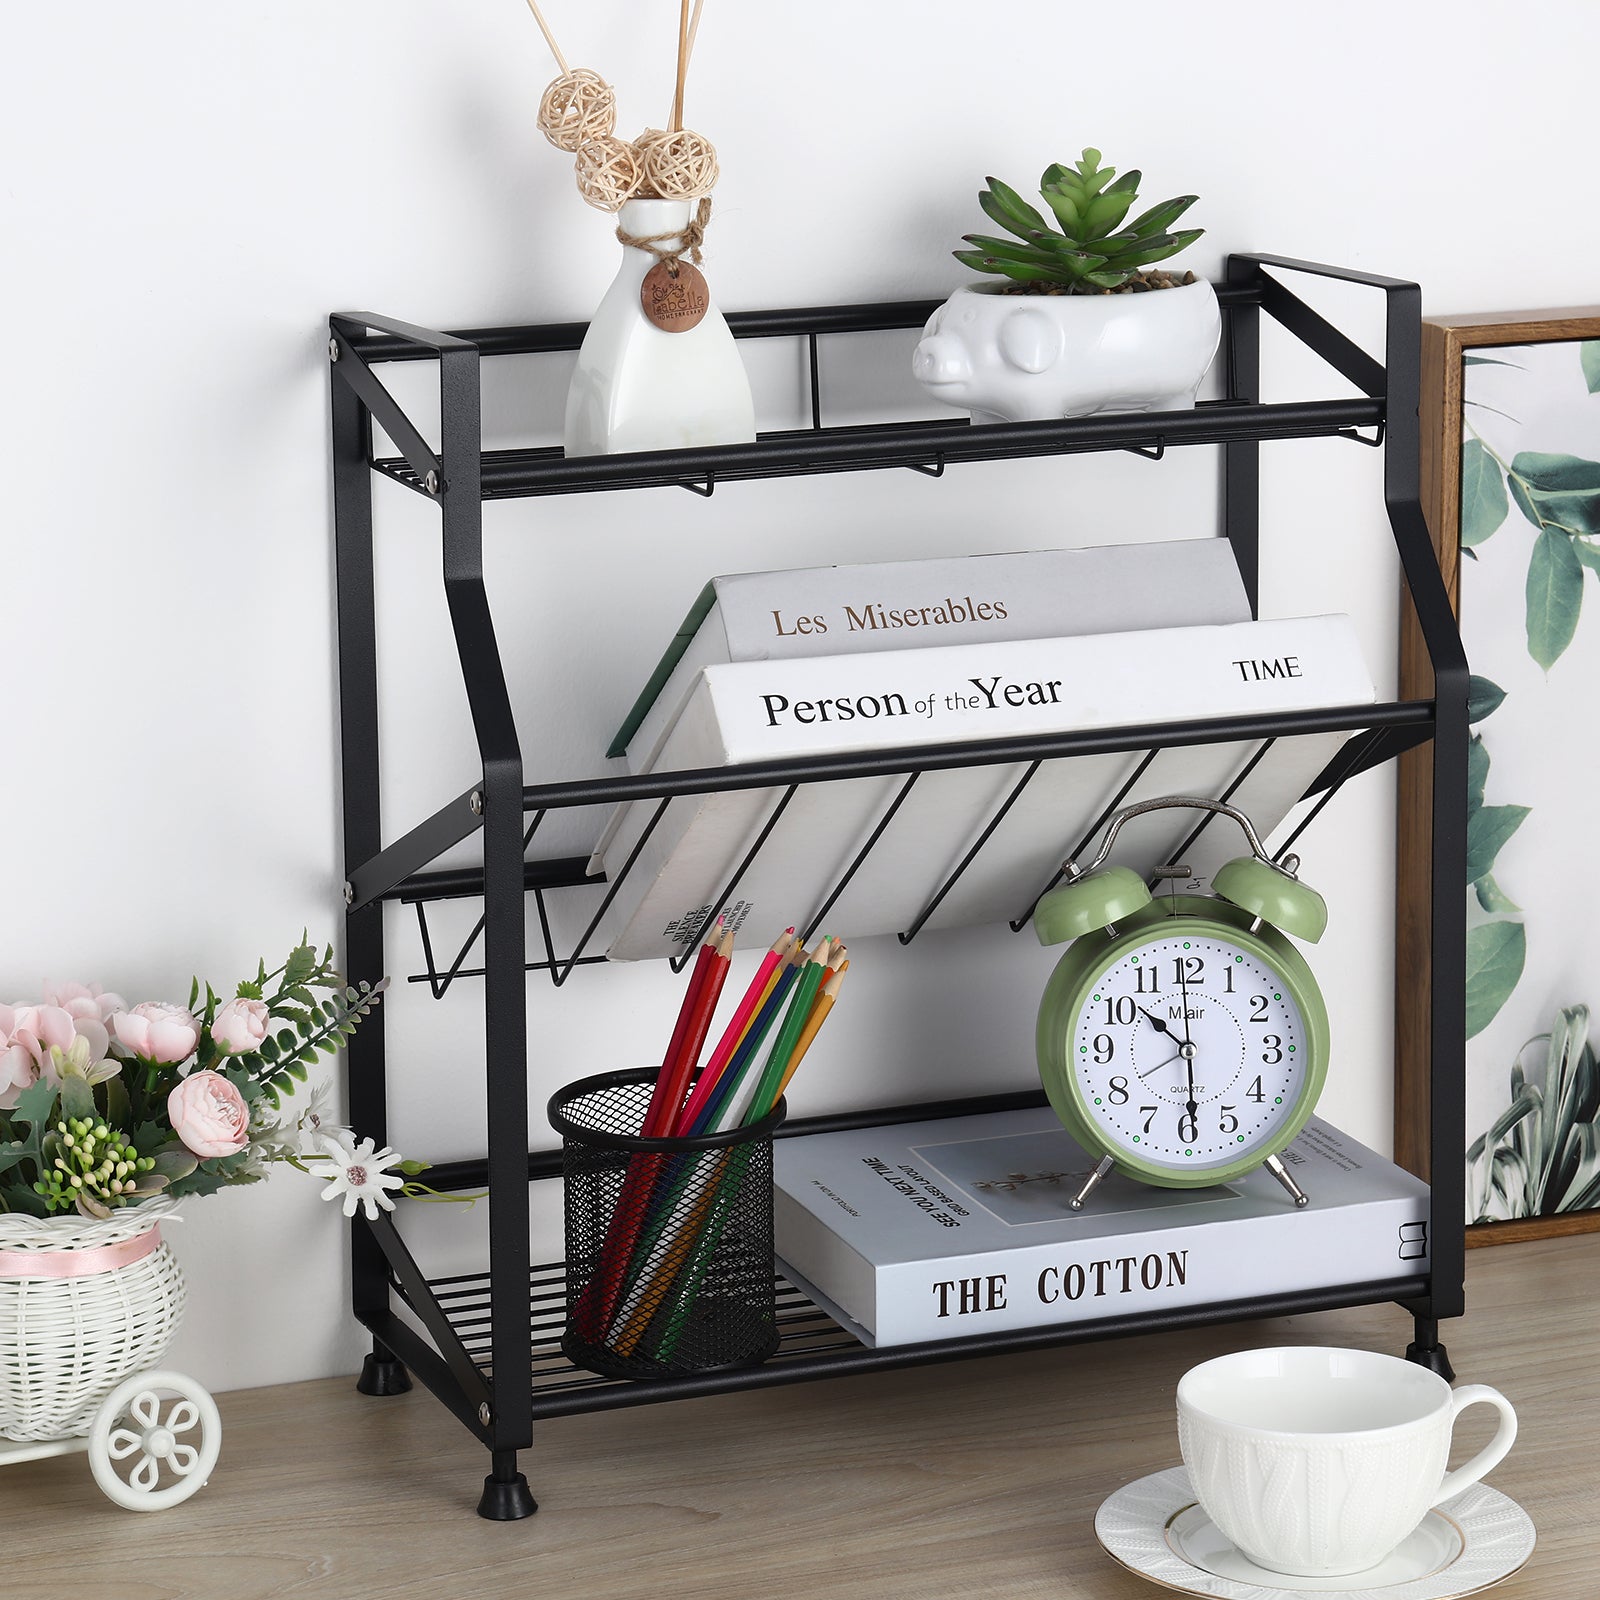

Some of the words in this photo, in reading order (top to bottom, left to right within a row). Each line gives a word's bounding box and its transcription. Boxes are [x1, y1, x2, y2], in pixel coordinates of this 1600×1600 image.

[771, 609, 828, 636] Les
[842, 596, 1008, 631] Miserables
[1232, 656, 1303, 681] TIME
[759, 691, 910, 727] Person
[914, 693, 936, 718] of
[968, 676, 1062, 709] Year
[663, 919, 681, 936] THE
[672, 909, 698, 942] SILENCE
[1134, 966, 1161, 993] 11
[1172, 957, 1205, 985] 12
[1223, 965, 1236, 993] 1
[1104, 996, 1137, 1025] 10
[1249, 995, 1269, 1022] 2
[1093, 1034, 1114, 1064] 9
[1262, 1035, 1283, 1064] 3
[1108, 1076, 1129, 1105] 8
[1245, 1075, 1266, 1103] 4
[1139, 1106, 1158, 1133] 7
[1178, 1113, 1198, 1143] 6
[1219, 1105, 1239, 1133] 5
[862, 1157, 893, 1176] TIME
[884, 1177, 920, 1196] NEXT
[909, 1197, 940, 1213] YOU
[931, 1213, 960, 1228] SEE
[932, 1274, 1007, 1318] THE
[1037, 1250, 1189, 1304] COTTON
